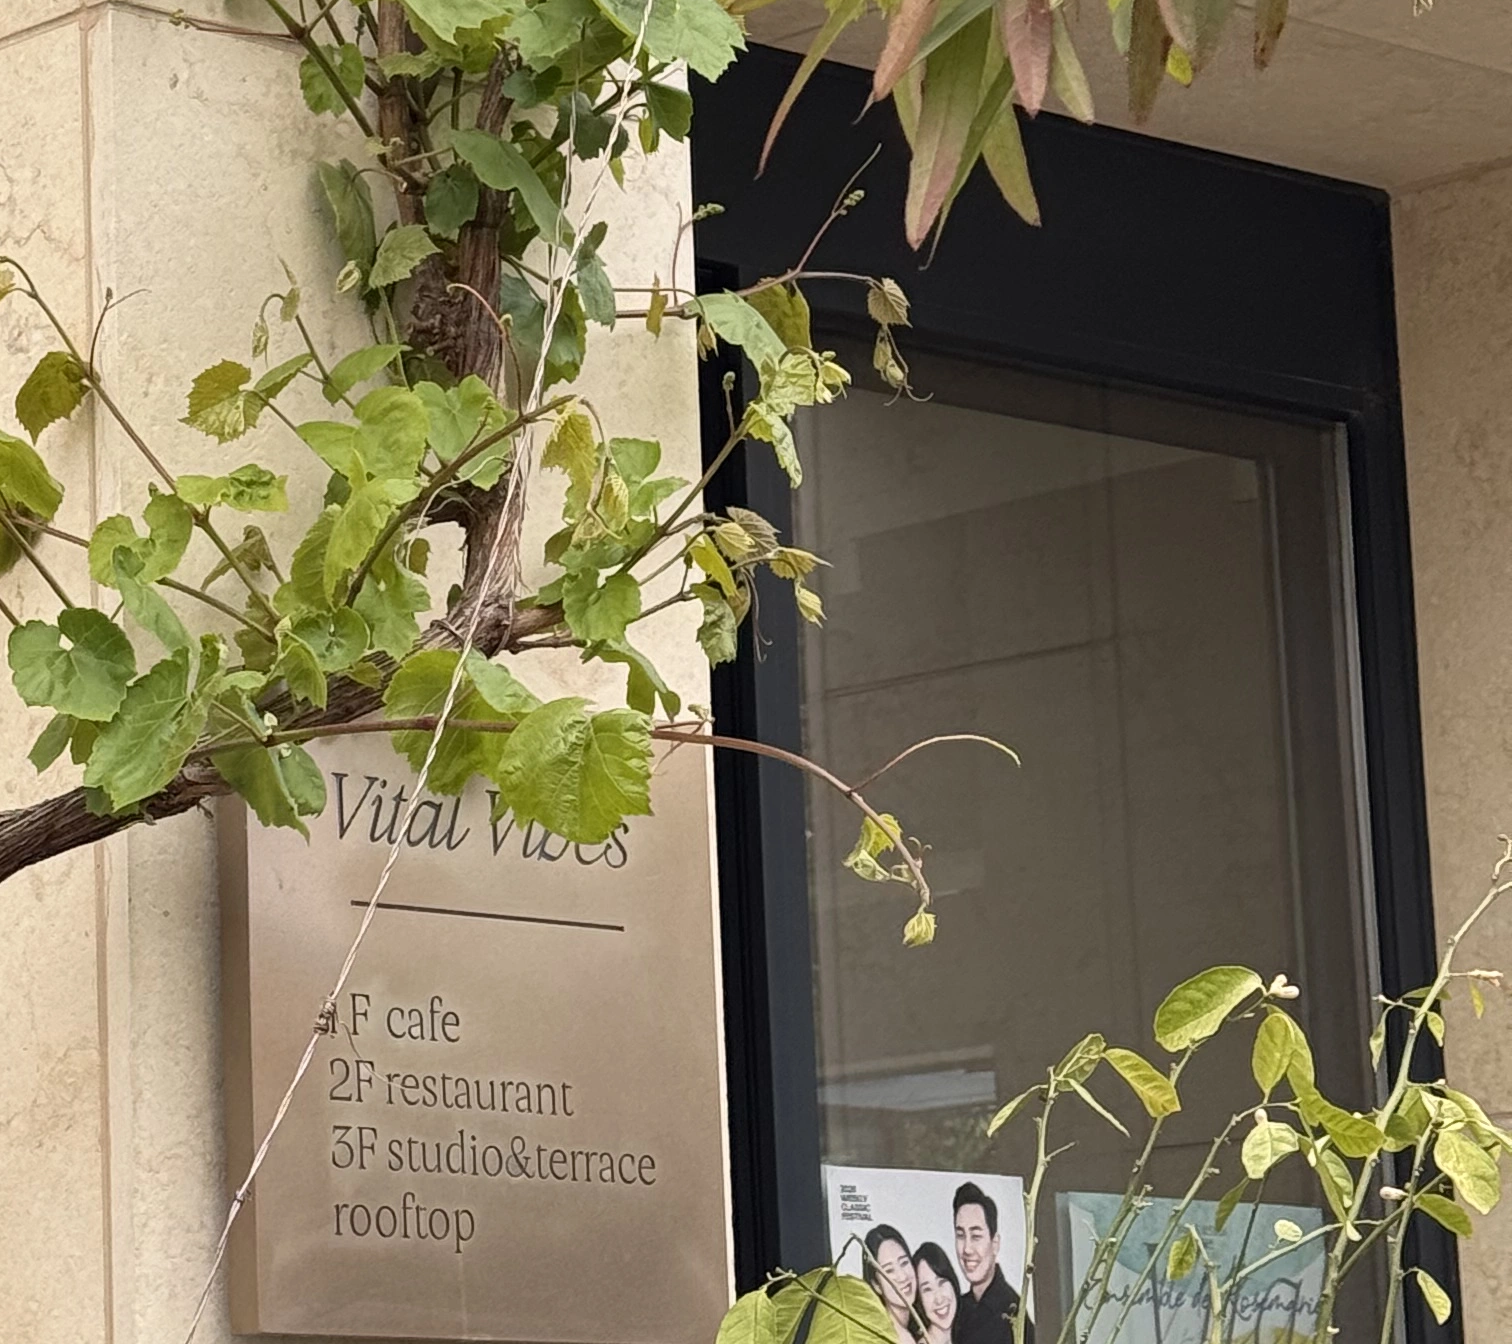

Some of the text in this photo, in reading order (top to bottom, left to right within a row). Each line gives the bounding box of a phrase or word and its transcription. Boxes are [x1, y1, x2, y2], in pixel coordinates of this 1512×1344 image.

[331, 771, 471, 851] Vital
[386, 995, 461, 1043] cafe
[329, 1057, 574, 1117] 2F restaurant
[331, 1124, 657, 1187] 3F studio&terrace
[333, 1192, 476, 1254] rooftop
